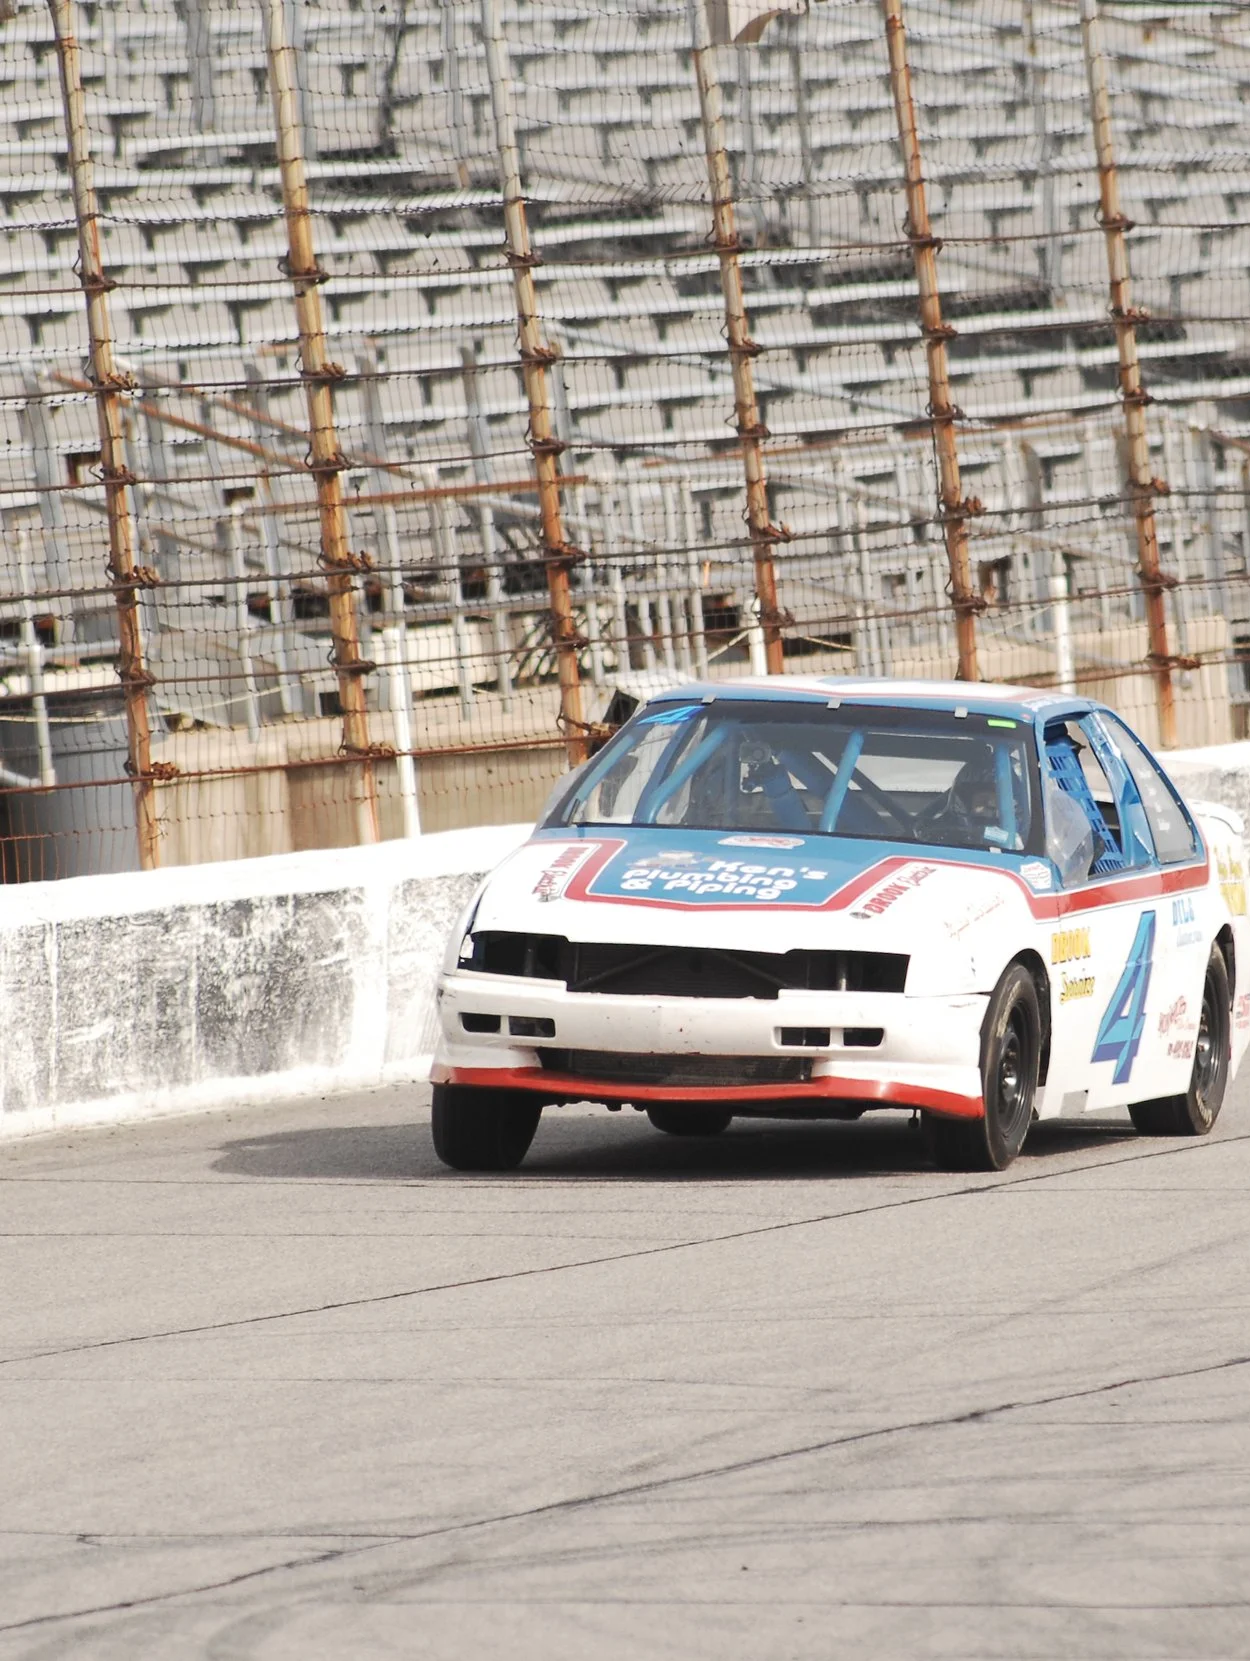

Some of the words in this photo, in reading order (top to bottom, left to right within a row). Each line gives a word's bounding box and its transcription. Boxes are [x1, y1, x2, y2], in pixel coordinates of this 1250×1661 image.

[622, 868, 799, 891] Plumbing
[708, 859, 829, 881] Ken's
[620, 878, 650, 891] &
[663, 880, 783, 900] Piping
[1090, 910, 1156, 1085] 4
